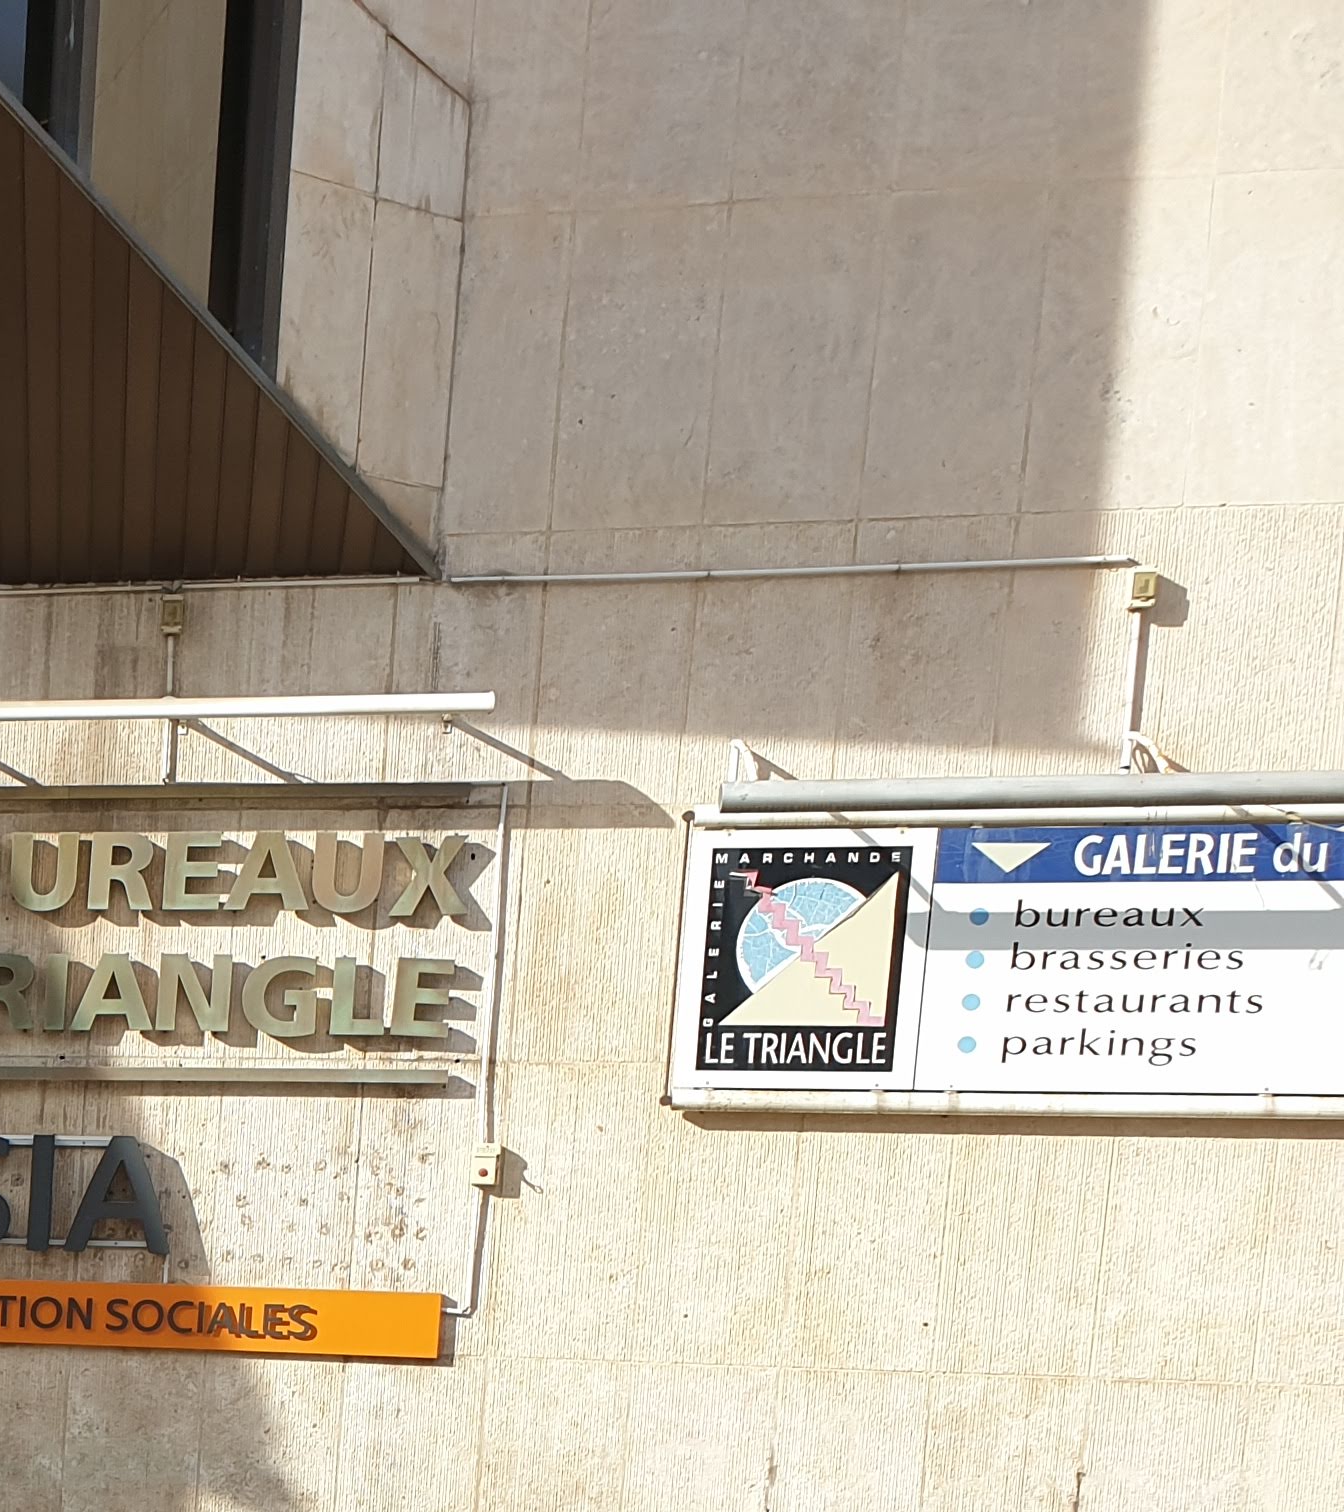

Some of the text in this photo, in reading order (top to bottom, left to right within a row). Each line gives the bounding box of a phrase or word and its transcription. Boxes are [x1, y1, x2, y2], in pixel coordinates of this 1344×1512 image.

[715, 850, 901, 865] MARCHANDE
[1074, 832, 1328, 875] GALERIE du
[1014, 899, 1204, 928] bureaux
[702, 878, 725, 1028] GALERIE
[1010, 941, 1245, 971] brasseries
[1005, 986, 1264, 1015] restaurants
[703, 1031, 887, 1065] LE TRIANGLE
[1000, 1028, 1198, 1067] parkings
[104, 1297, 314, 1340] SOCIALES
